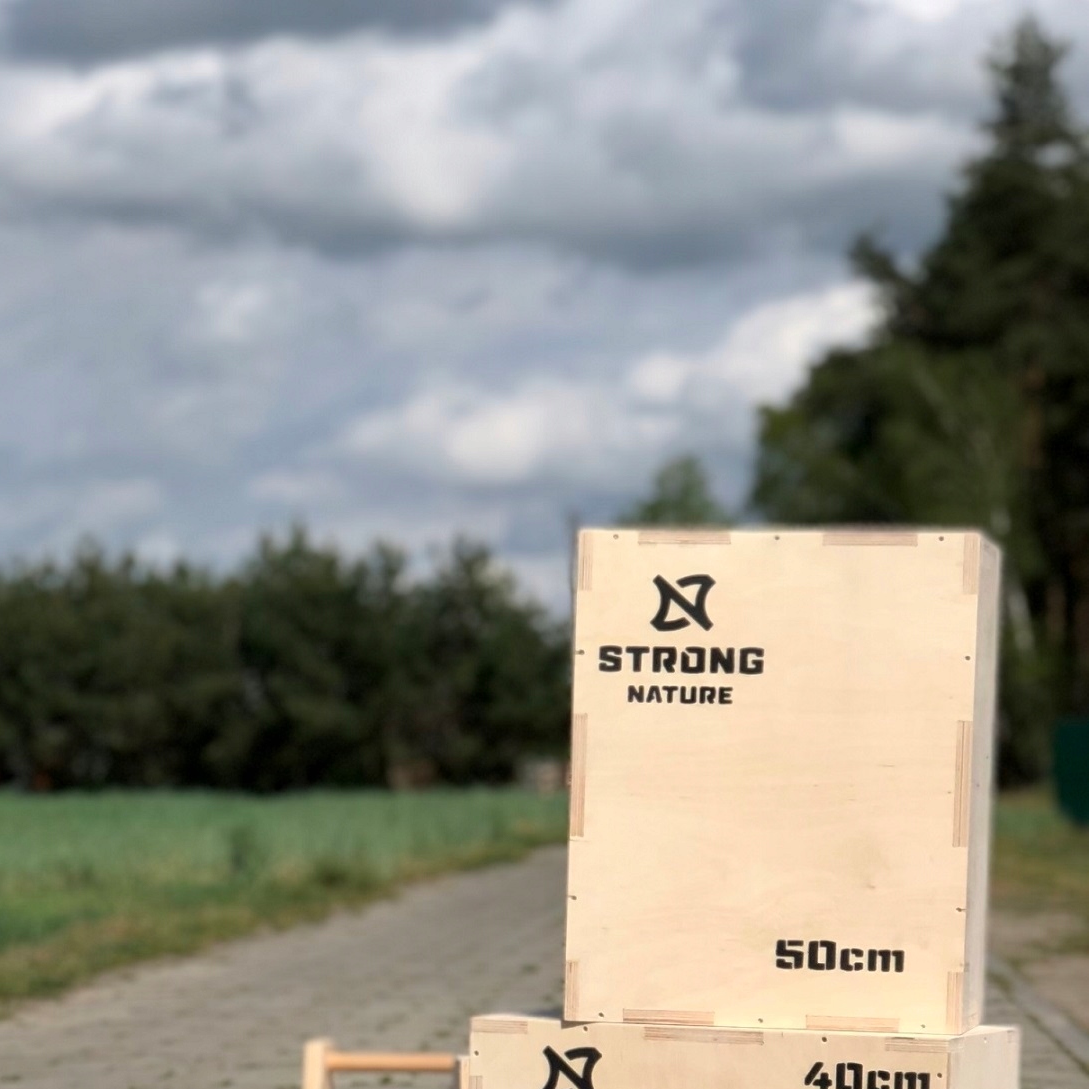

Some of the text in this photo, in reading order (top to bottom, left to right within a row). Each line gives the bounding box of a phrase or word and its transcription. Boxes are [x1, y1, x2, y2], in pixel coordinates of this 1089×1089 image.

[598, 645, 765, 675] STRONG
[627, 685, 734, 705] NATURE
[775, 939, 905, 973] 50cm
